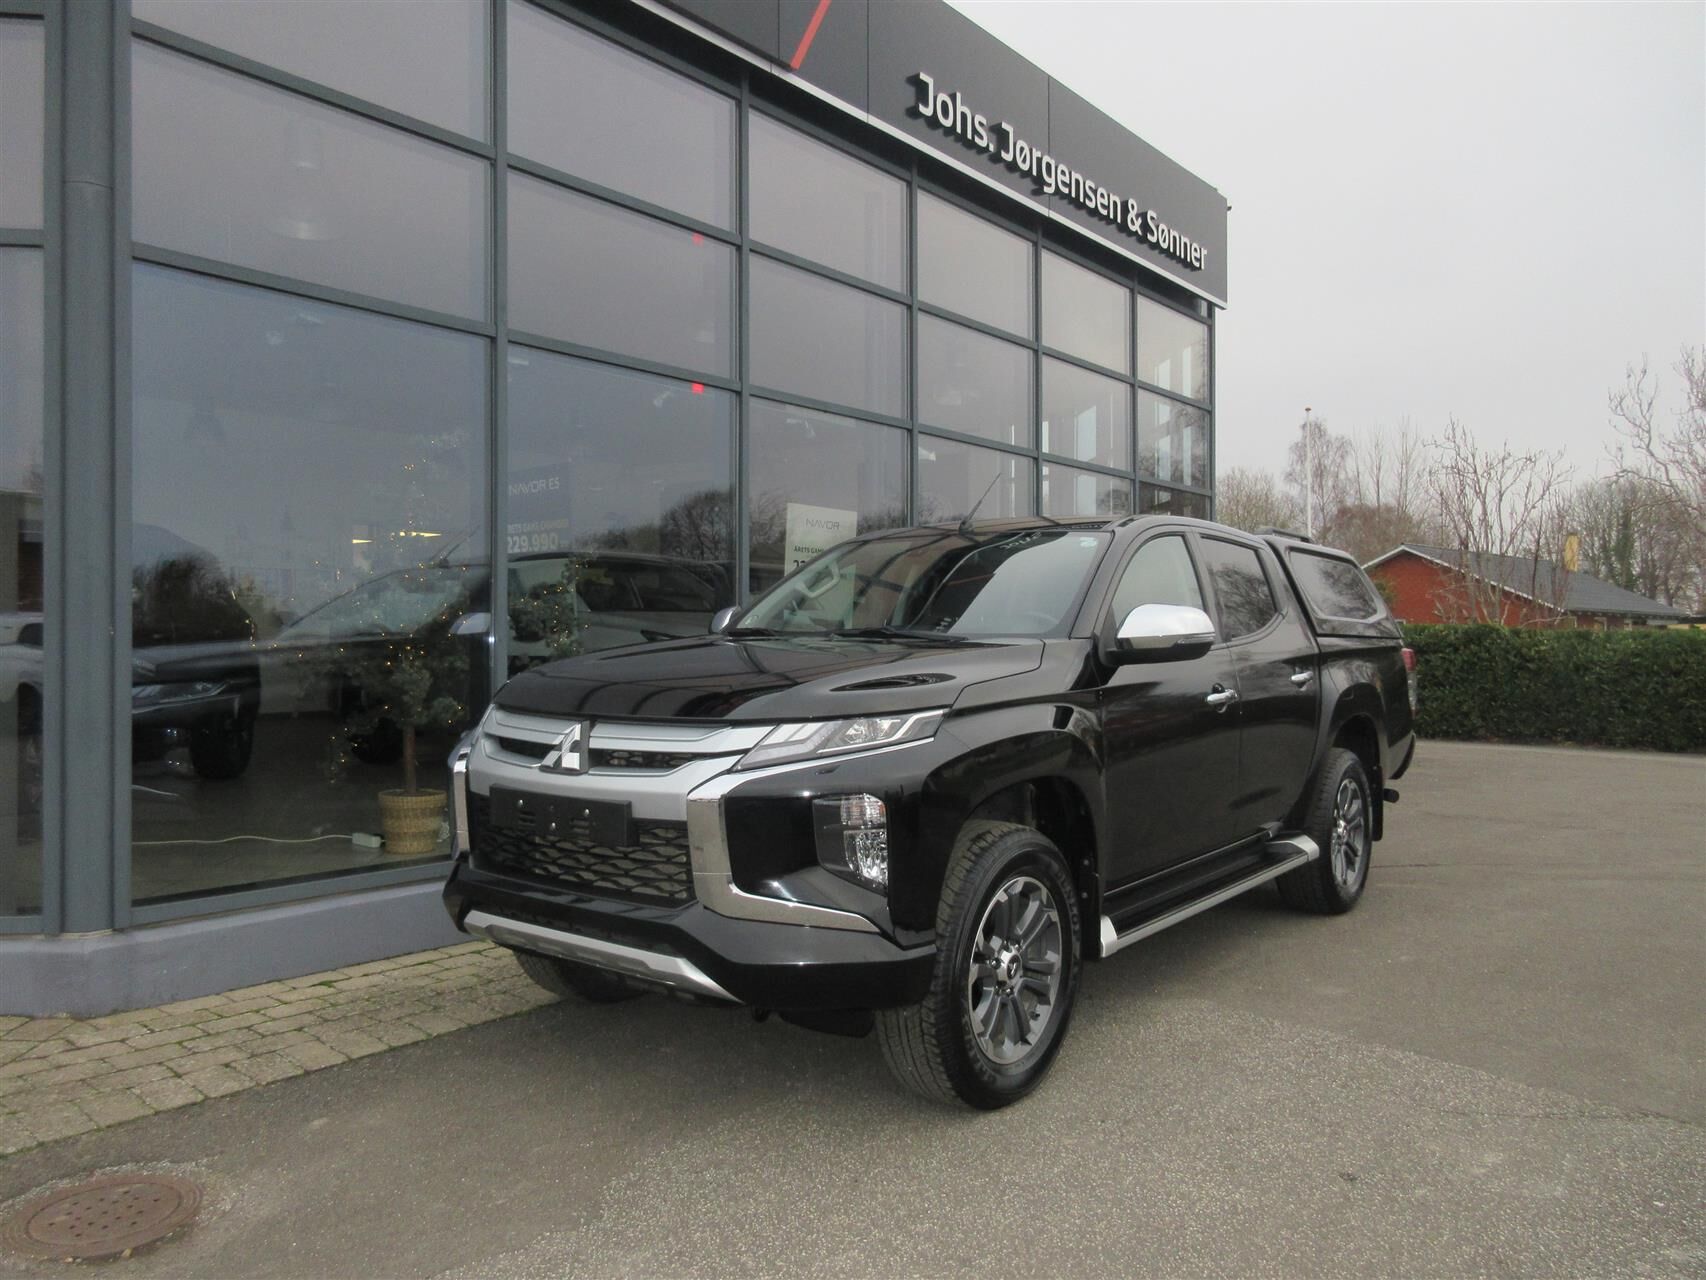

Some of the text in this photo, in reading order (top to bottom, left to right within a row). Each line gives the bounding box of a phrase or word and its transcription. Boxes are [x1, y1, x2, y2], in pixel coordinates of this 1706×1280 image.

[918, 71, 1208, 270] Johs. Jørgensen & Sønner
